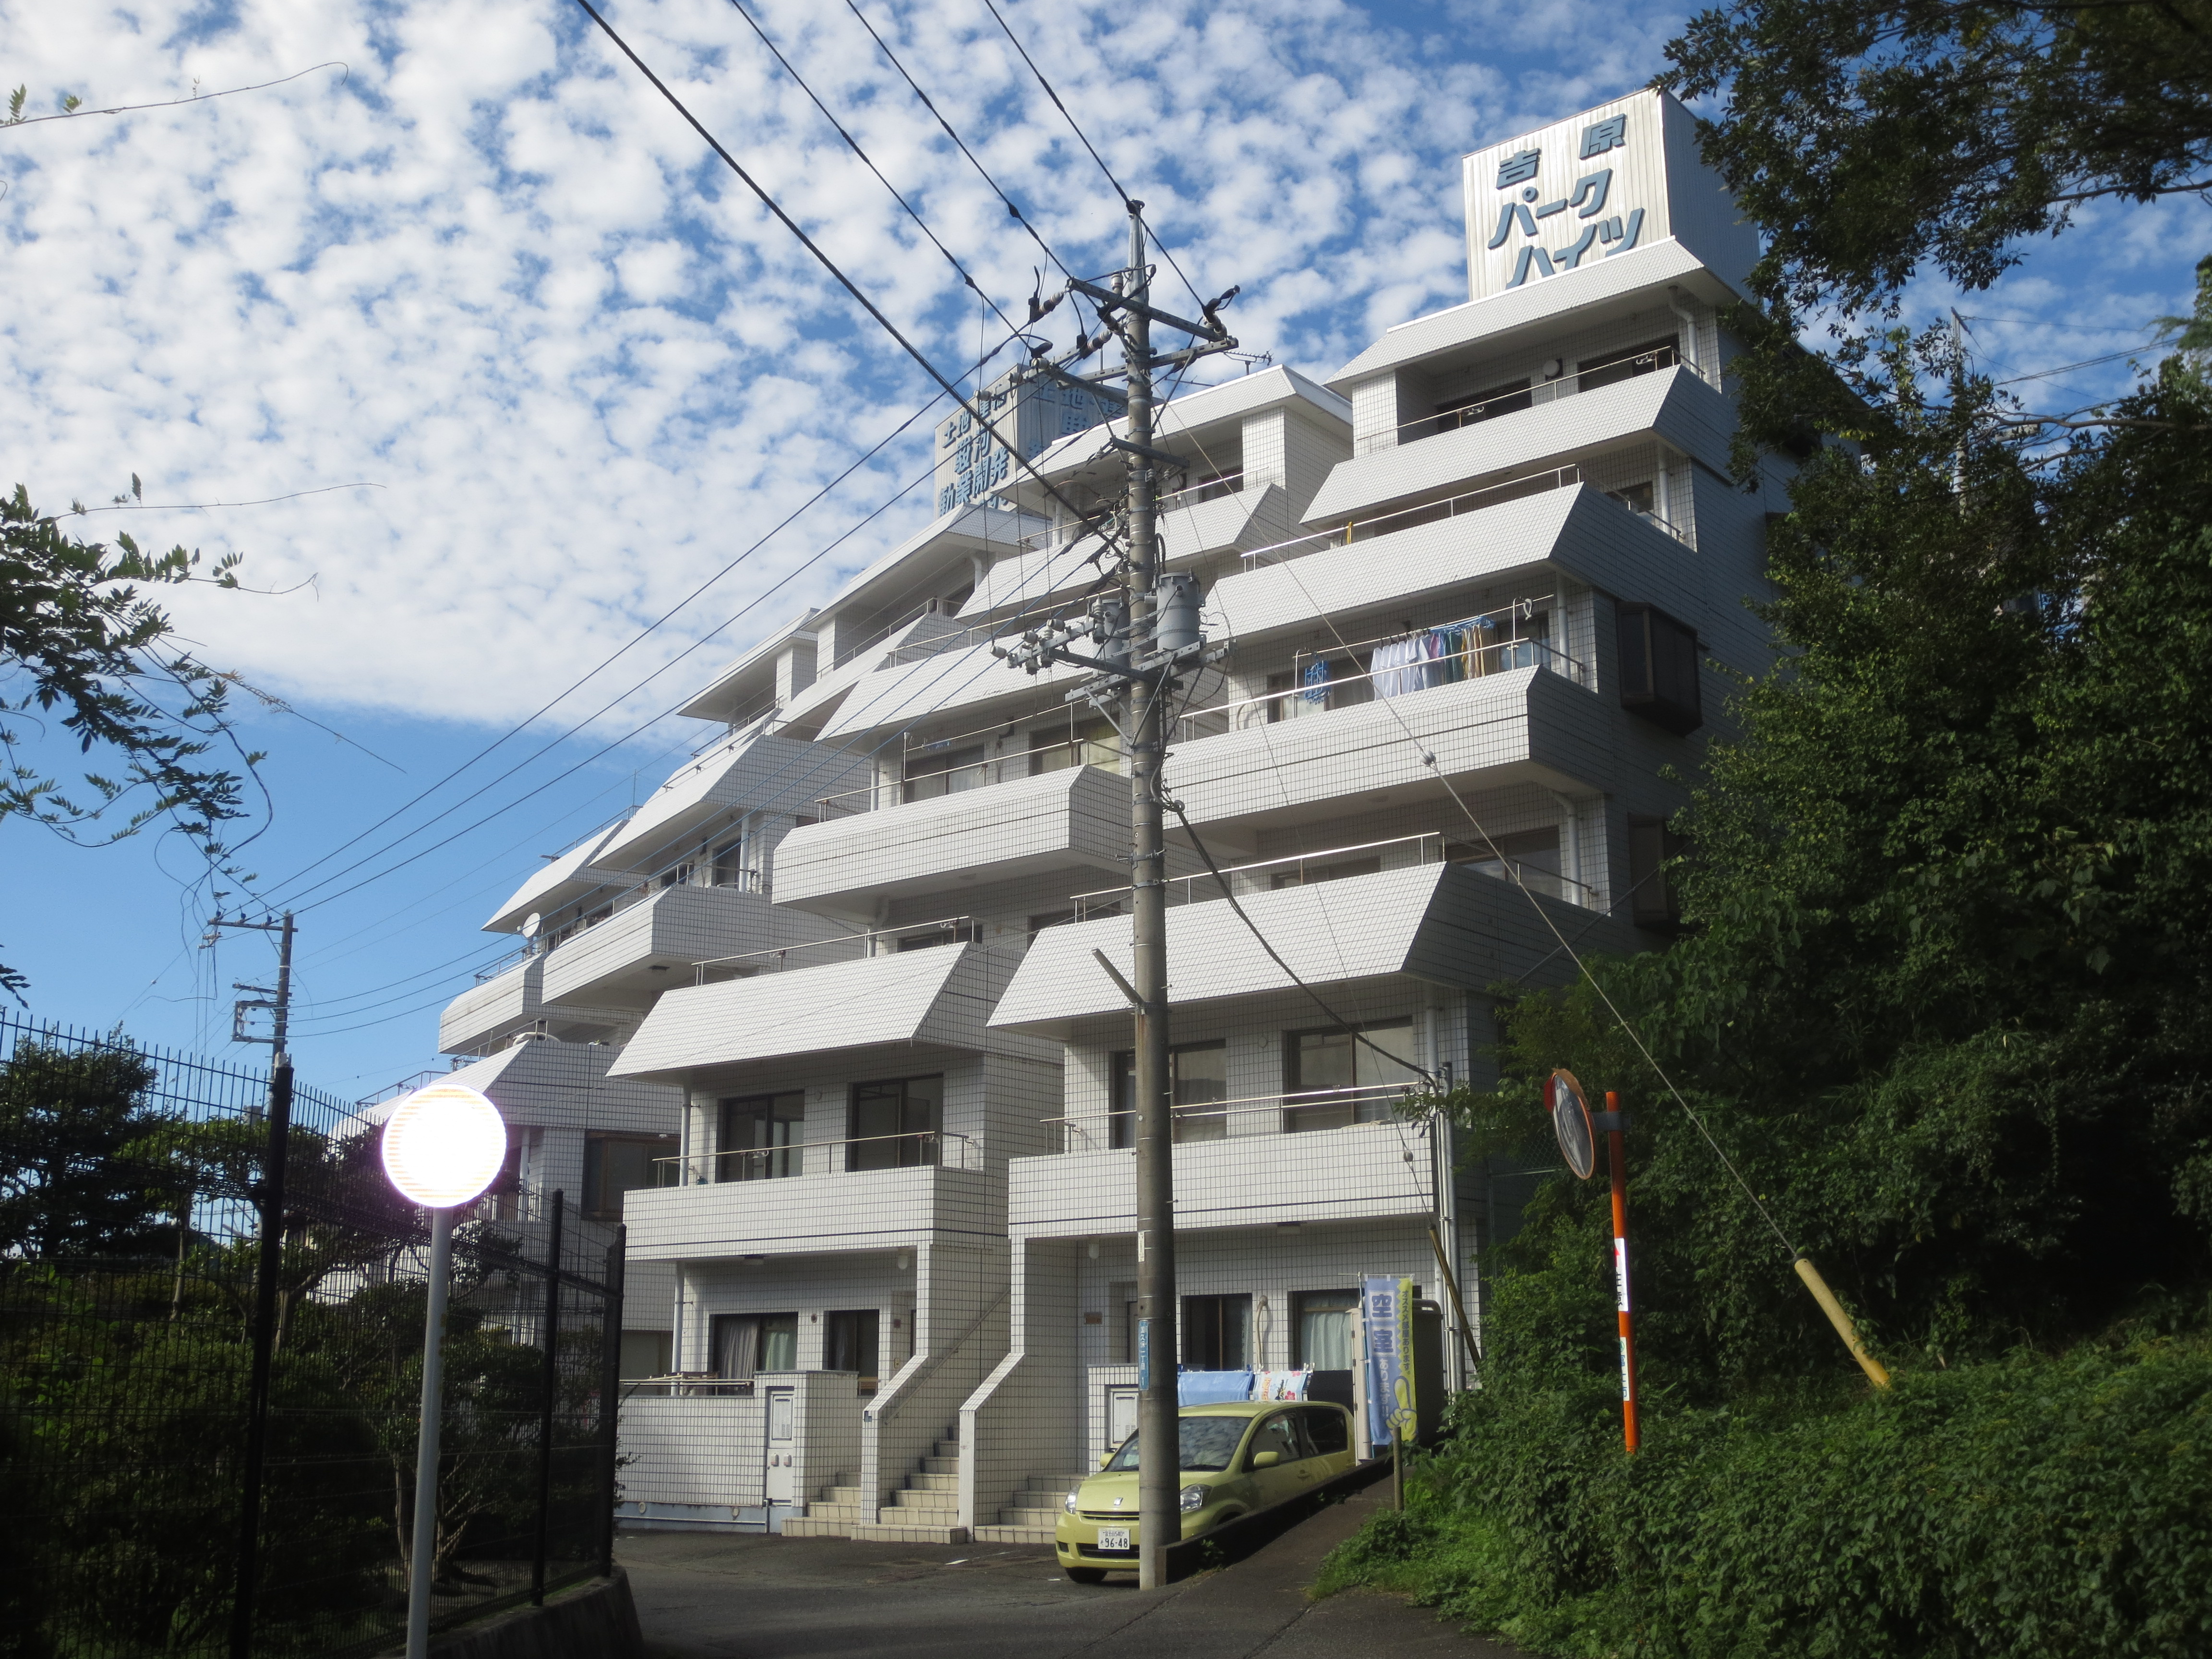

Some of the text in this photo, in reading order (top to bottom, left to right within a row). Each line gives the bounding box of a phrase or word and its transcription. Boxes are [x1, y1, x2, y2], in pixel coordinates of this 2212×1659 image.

[1497, 113, 1626, 189] 吉原
[1488, 168, 1613, 250] パーク
[1505, 207, 1646, 289] ハイツ
[1105, 1538, 1128, 1548] 96-48
